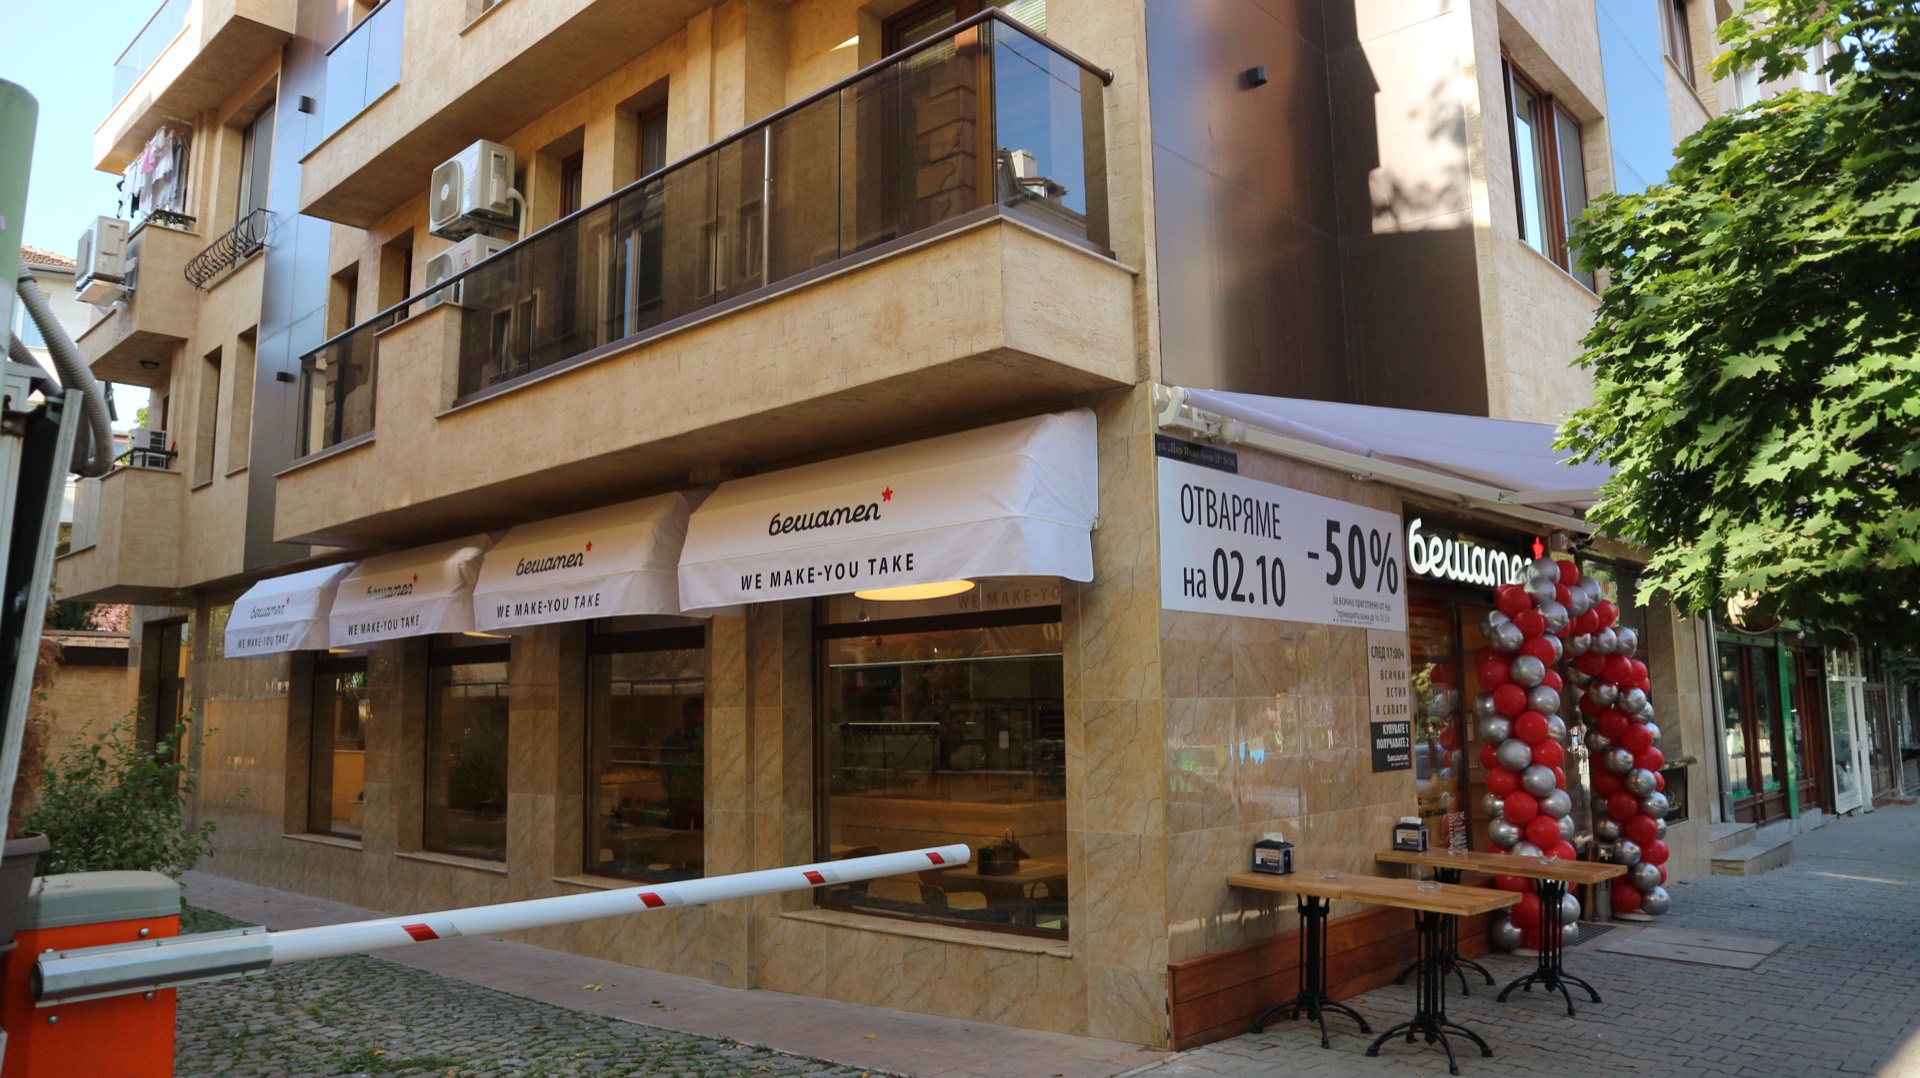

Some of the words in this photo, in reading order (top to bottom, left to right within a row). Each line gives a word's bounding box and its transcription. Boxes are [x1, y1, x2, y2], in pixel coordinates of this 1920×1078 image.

[768, 502, 881, 536] бешамел
[1180, 483, 1282, 540] ОТВАРЯМЕ
[516, 552, 584, 576] бешамел
[1307, 519, 1399, 595] -50%
[740, 575, 763, 591] WE
[770, 560, 859, 588] MAKE-YOU
[868, 552, 915, 577] TAKE
[1183, 567, 1207, 599] на
[1212, 547, 1286, 607] 02.10
[496, 605, 510, 618] WE
[514, 597, 569, 617] MAKE-YOU
[574, 593, 600, 609] TAKE
[957, 593, 979, 609] WE
[348, 625, 358, 636] WE
[361, 619, 398, 634] MAKE-YOU
[401, 615, 420, 628] TAKE
[238, 639, 246, 649] WE
[275, 633, 290, 645] TAKE
[1371, 646, 1386, 660] СЛЕД
[1380, 669, 1406, 680] ВСИЧКИ
[1386, 687, 1407, 698] ЯСТИЯ
[1376, 704, 1380, 715] И
[1382, 704, 1407, 716] САЛАТИ
